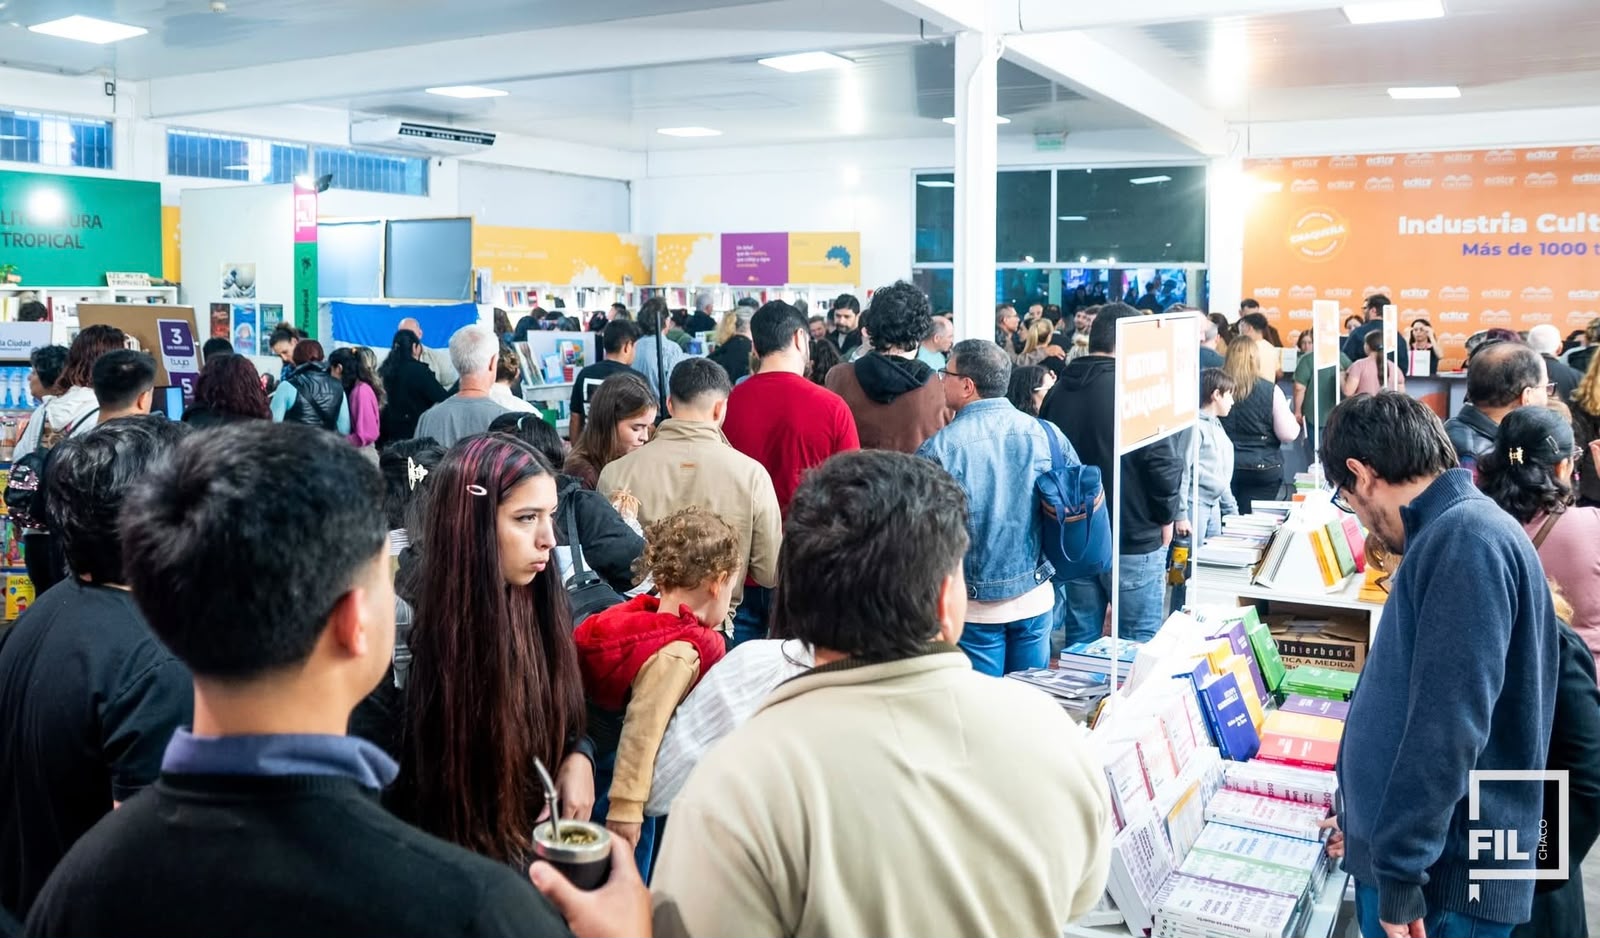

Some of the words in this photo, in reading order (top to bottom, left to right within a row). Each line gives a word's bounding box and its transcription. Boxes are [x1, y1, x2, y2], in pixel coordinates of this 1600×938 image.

[1399, 212, 1527, 235] Industria
[1, 232, 84, 249] TROPICAL
[1462, 242, 1502, 256] Más
[1507, 242, 1533, 256] de
[1538, 242, 1588, 256] 1000
[7, 339, 31, 347] Ciudad
[171, 328, 183, 345] 3
[181, 378, 193, 394] 5
[1314, 660, 1355, 669] MEDIDA
